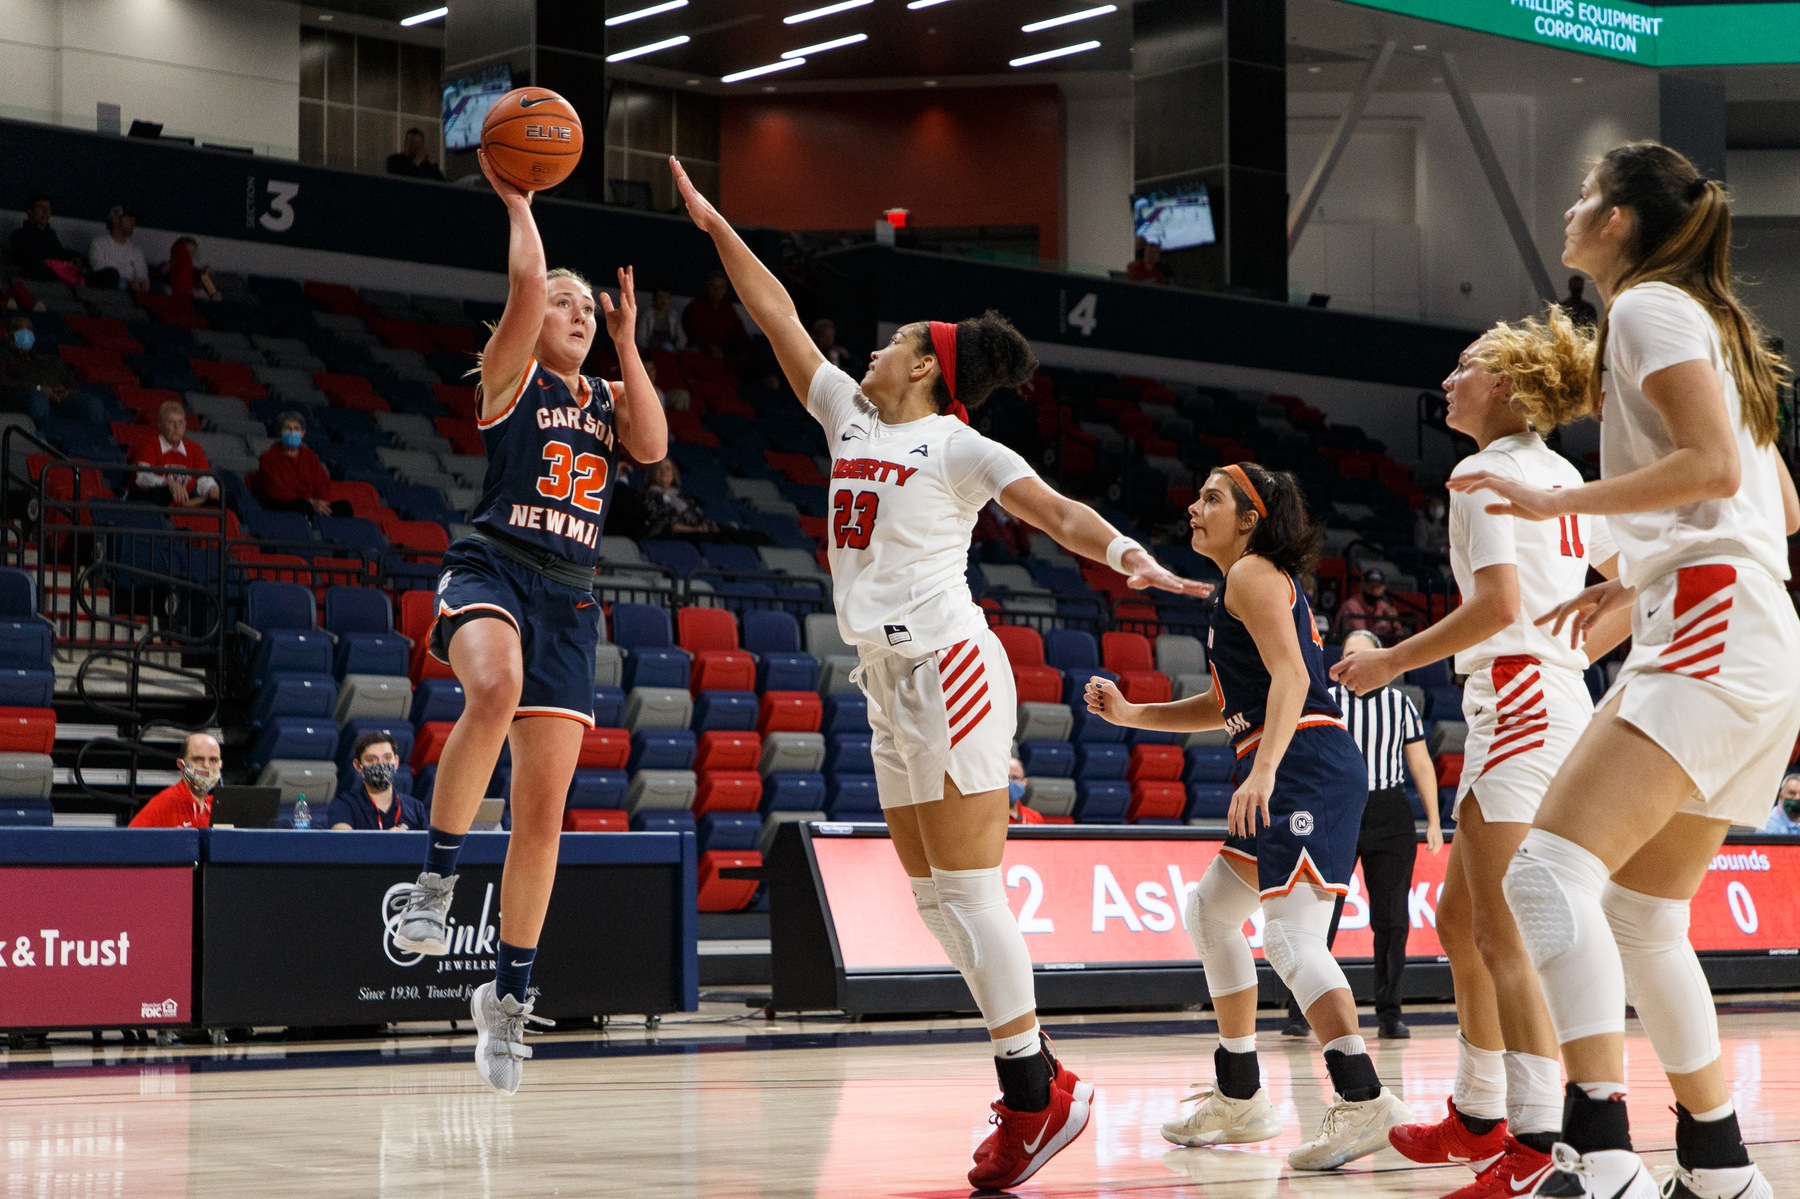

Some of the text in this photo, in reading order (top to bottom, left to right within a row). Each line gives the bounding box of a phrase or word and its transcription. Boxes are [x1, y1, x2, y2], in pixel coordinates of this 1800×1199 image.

[1534, 16, 1637, 54] CORPORATION
[1578, 3, 1663, 36] EQUIPMENT
[525, 125, 571, 140] ELITE
[259, 180, 299, 232] 3
[1068, 293, 1097, 336] 4
[536, 440, 608, 515] 32
[833, 489, 880, 550] 23
[1006, 864, 1054, 934] 2
[1727, 880, 1759, 935] 0
[12, 936, 36, 967] &
[40, 929, 130, 966] Trust
[437, 959, 497, 974] JEWELER
[358, 986, 387, 1001] Since
[390, 985, 421, 1000] 1930.
[426, 984, 467, 1000] Trusted
